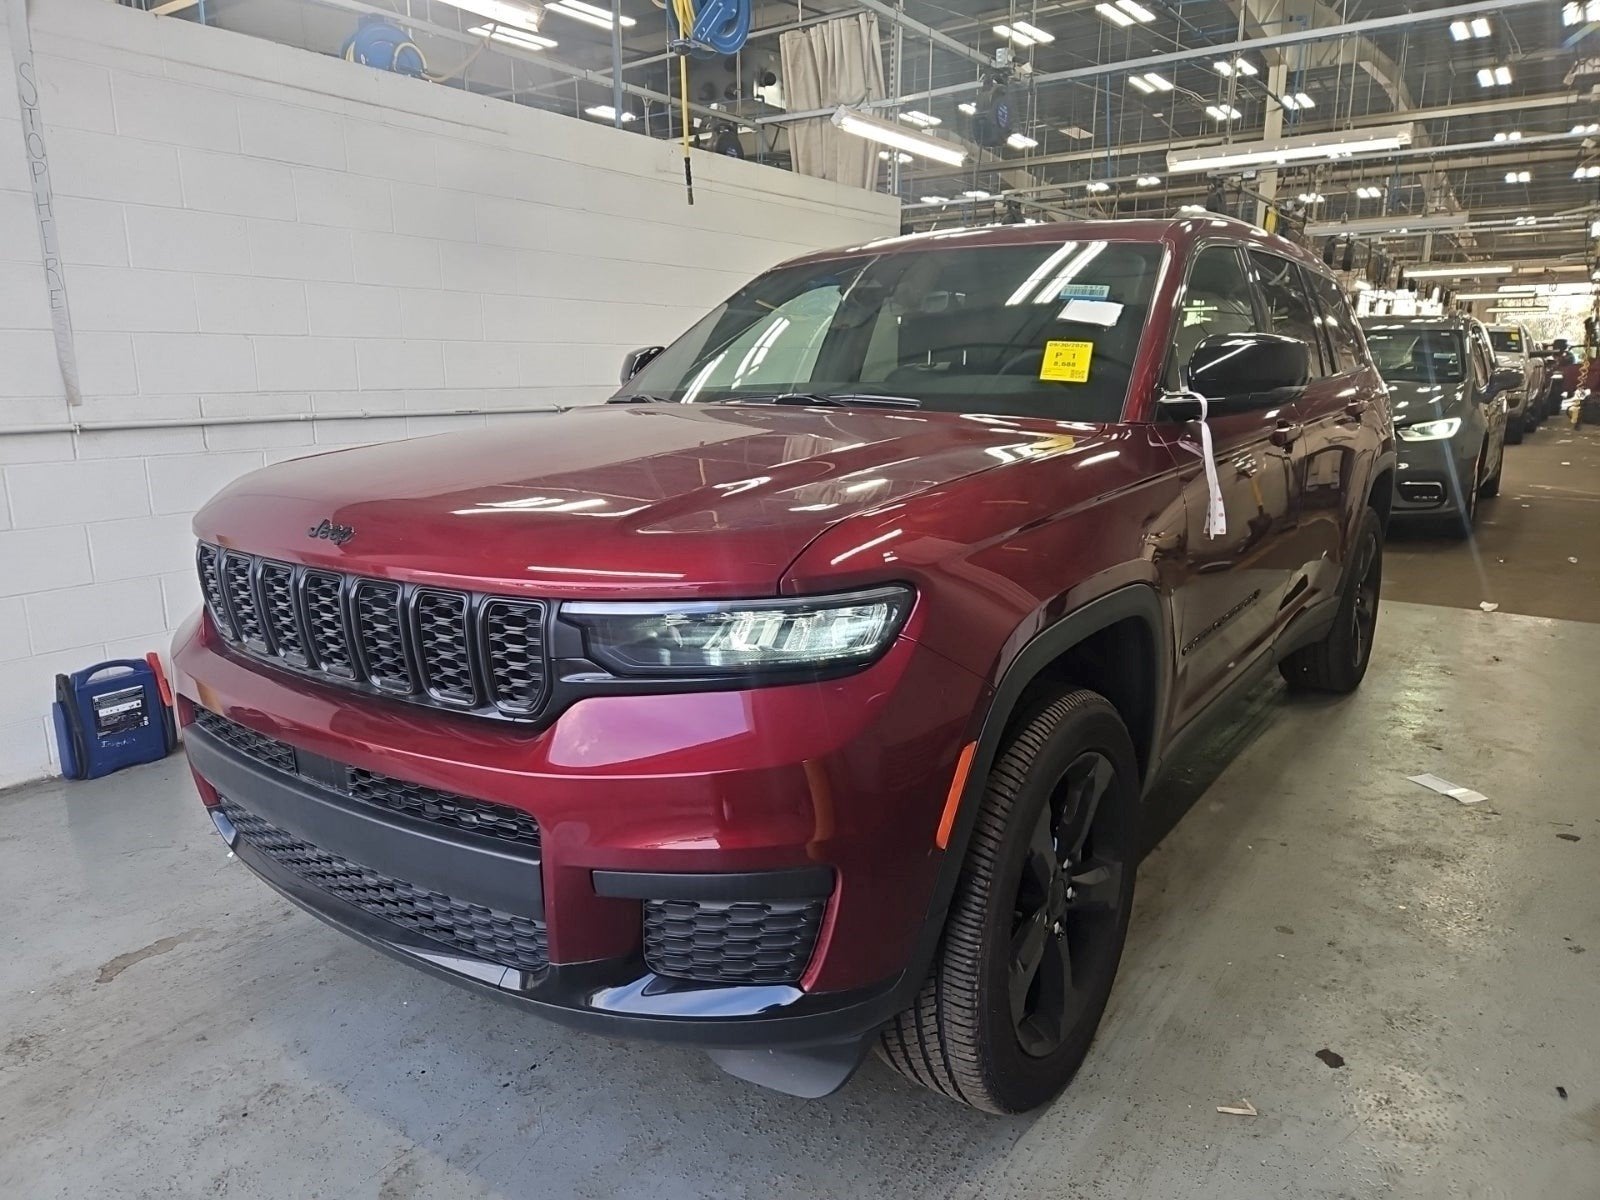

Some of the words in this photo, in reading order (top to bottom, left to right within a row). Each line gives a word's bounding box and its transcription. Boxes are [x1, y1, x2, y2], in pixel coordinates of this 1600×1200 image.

[19, 62, 47, 184] STOP
[35, 191, 63, 310] HERE
[308, 518, 357, 546] Jeep
